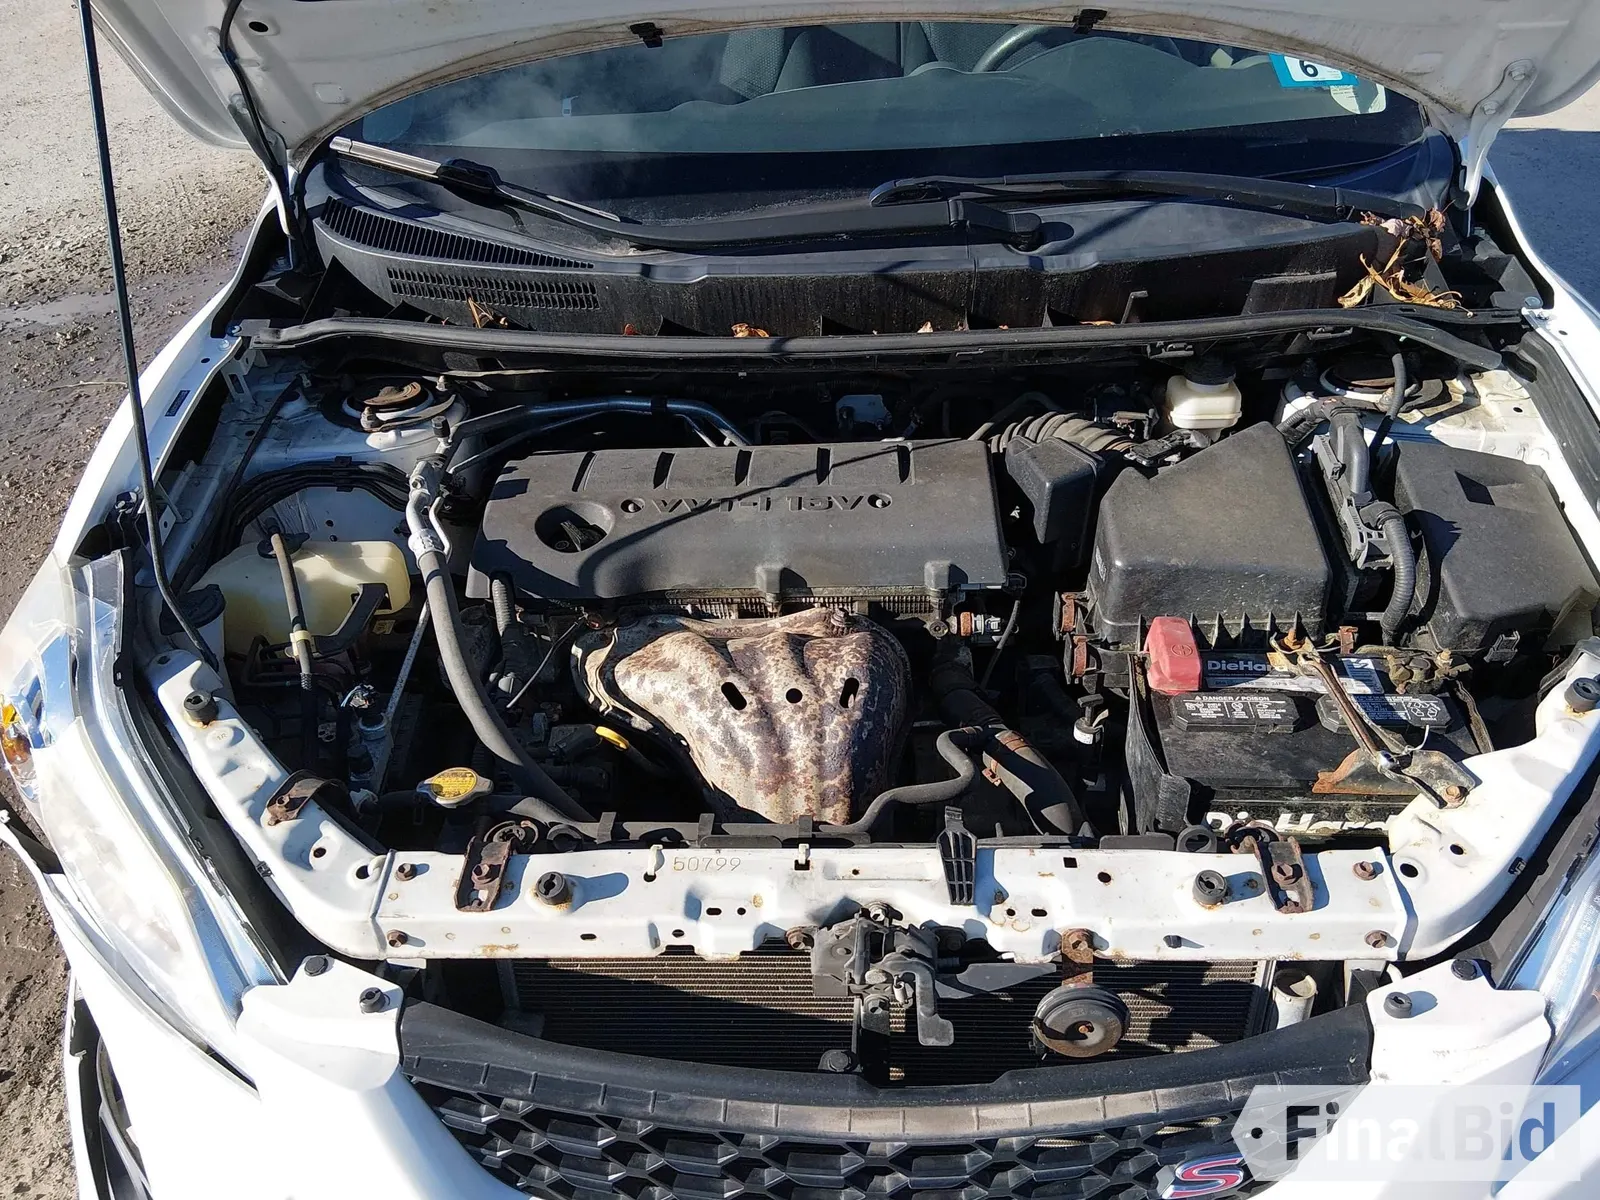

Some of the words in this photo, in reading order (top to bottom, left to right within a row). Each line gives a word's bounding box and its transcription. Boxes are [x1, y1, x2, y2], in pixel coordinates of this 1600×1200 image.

[1299, 60, 1318, 77] 6
[1206, 812, 1398, 832] DiHard
[673, 856, 741, 872] 50799
[1162, 1154, 1244, 1200] S
